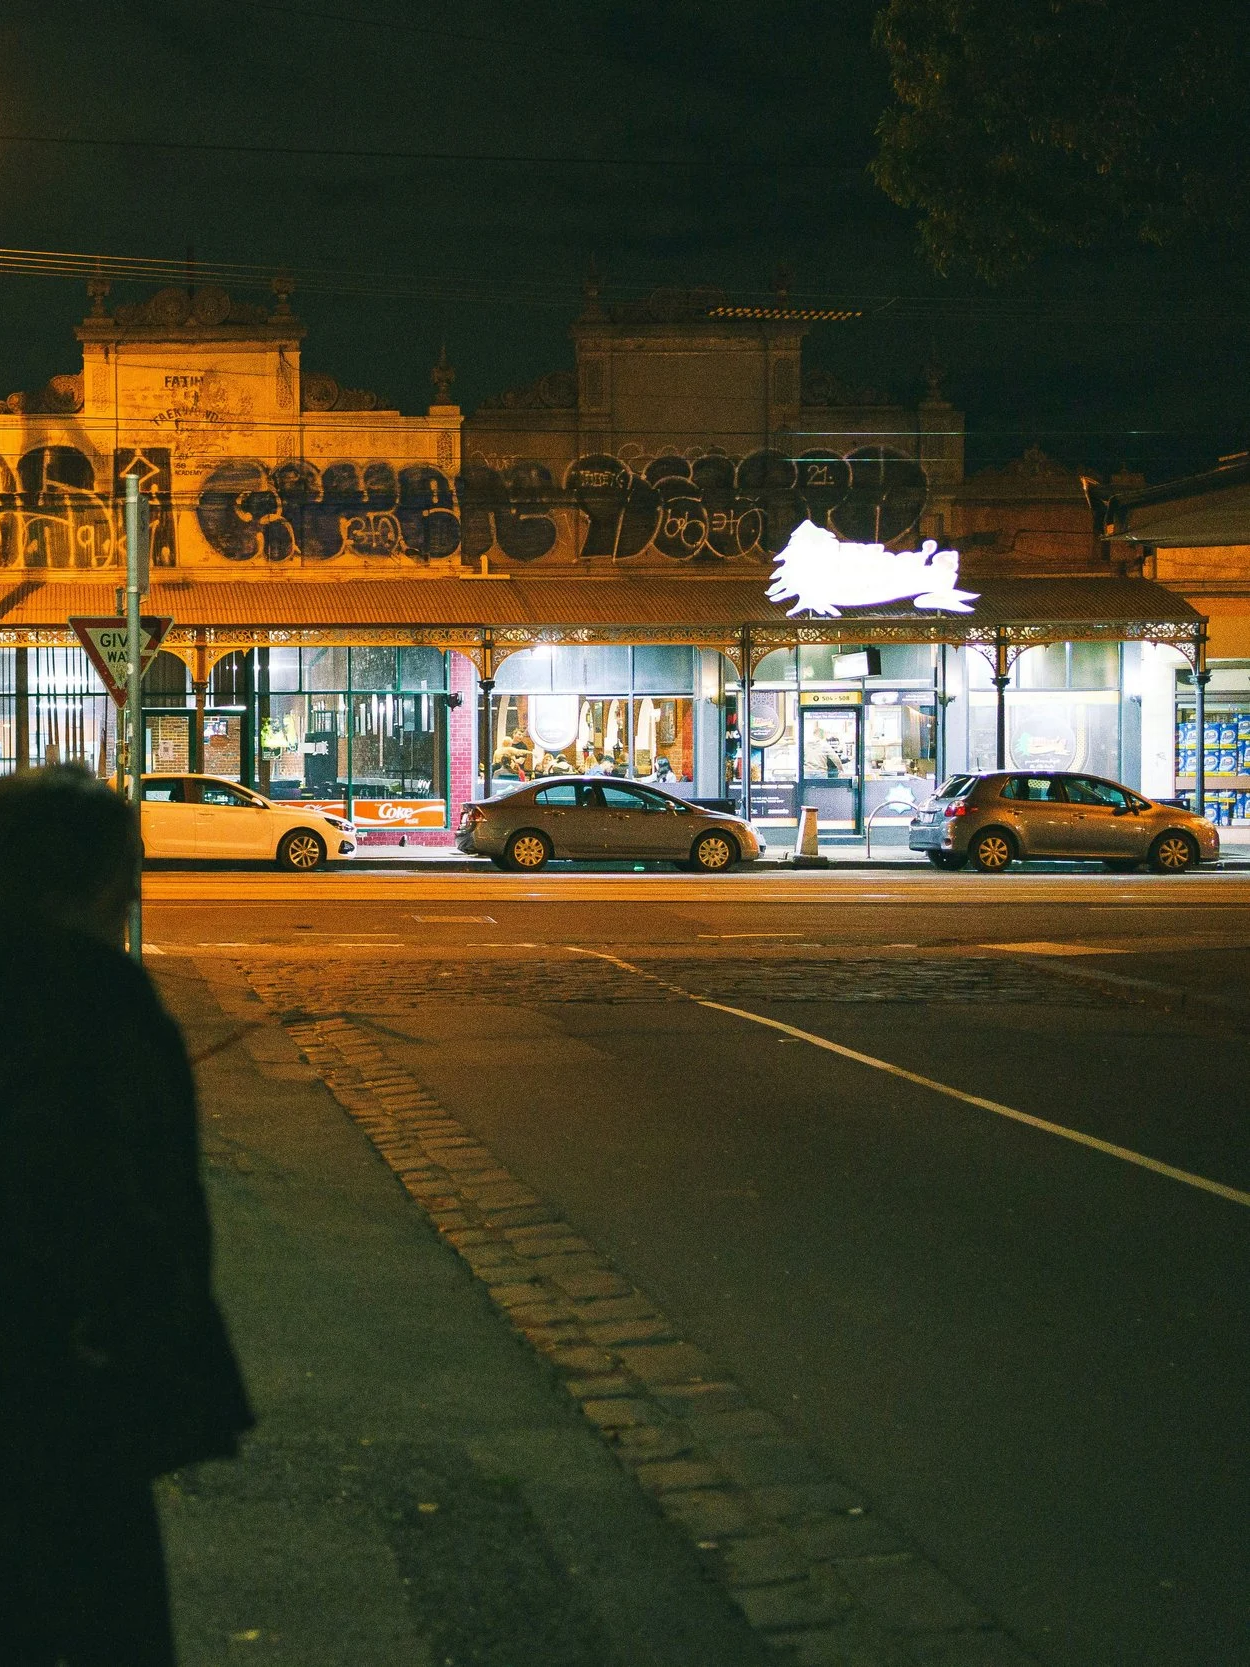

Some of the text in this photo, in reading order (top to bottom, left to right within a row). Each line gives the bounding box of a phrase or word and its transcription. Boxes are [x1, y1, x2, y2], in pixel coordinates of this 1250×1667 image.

[164, 375, 204, 388] FATIH
[99, 633, 129, 648] GIV
[107, 651, 129, 663] WA
[378, 802, 414, 819] Coke
